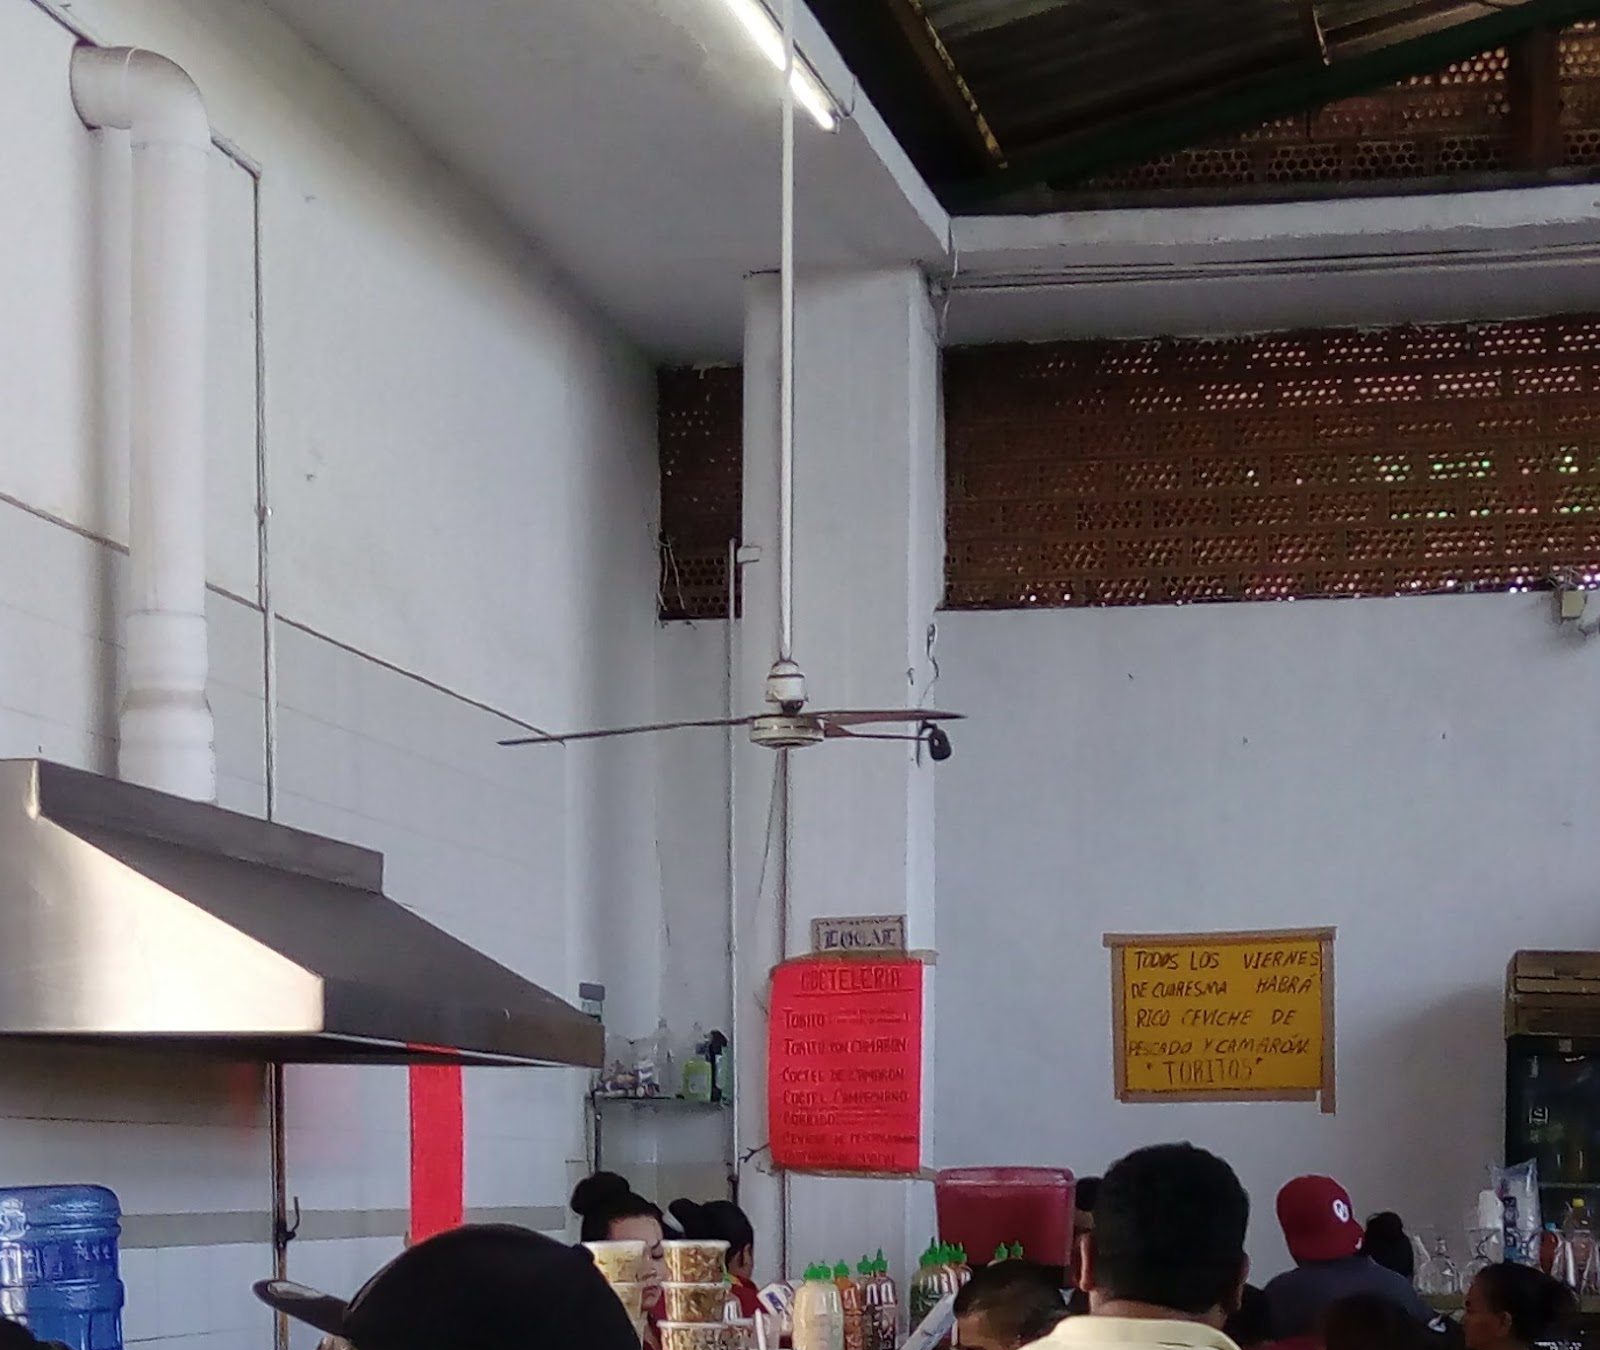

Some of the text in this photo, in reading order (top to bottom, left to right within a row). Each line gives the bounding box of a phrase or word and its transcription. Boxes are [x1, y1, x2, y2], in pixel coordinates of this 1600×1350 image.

[1134, 950, 1320, 970] TODOS LOS VIERNES
[1131, 981, 1148, 999] DE
[1136, 1008, 1297, 1028] RICO CEVICHE DE
